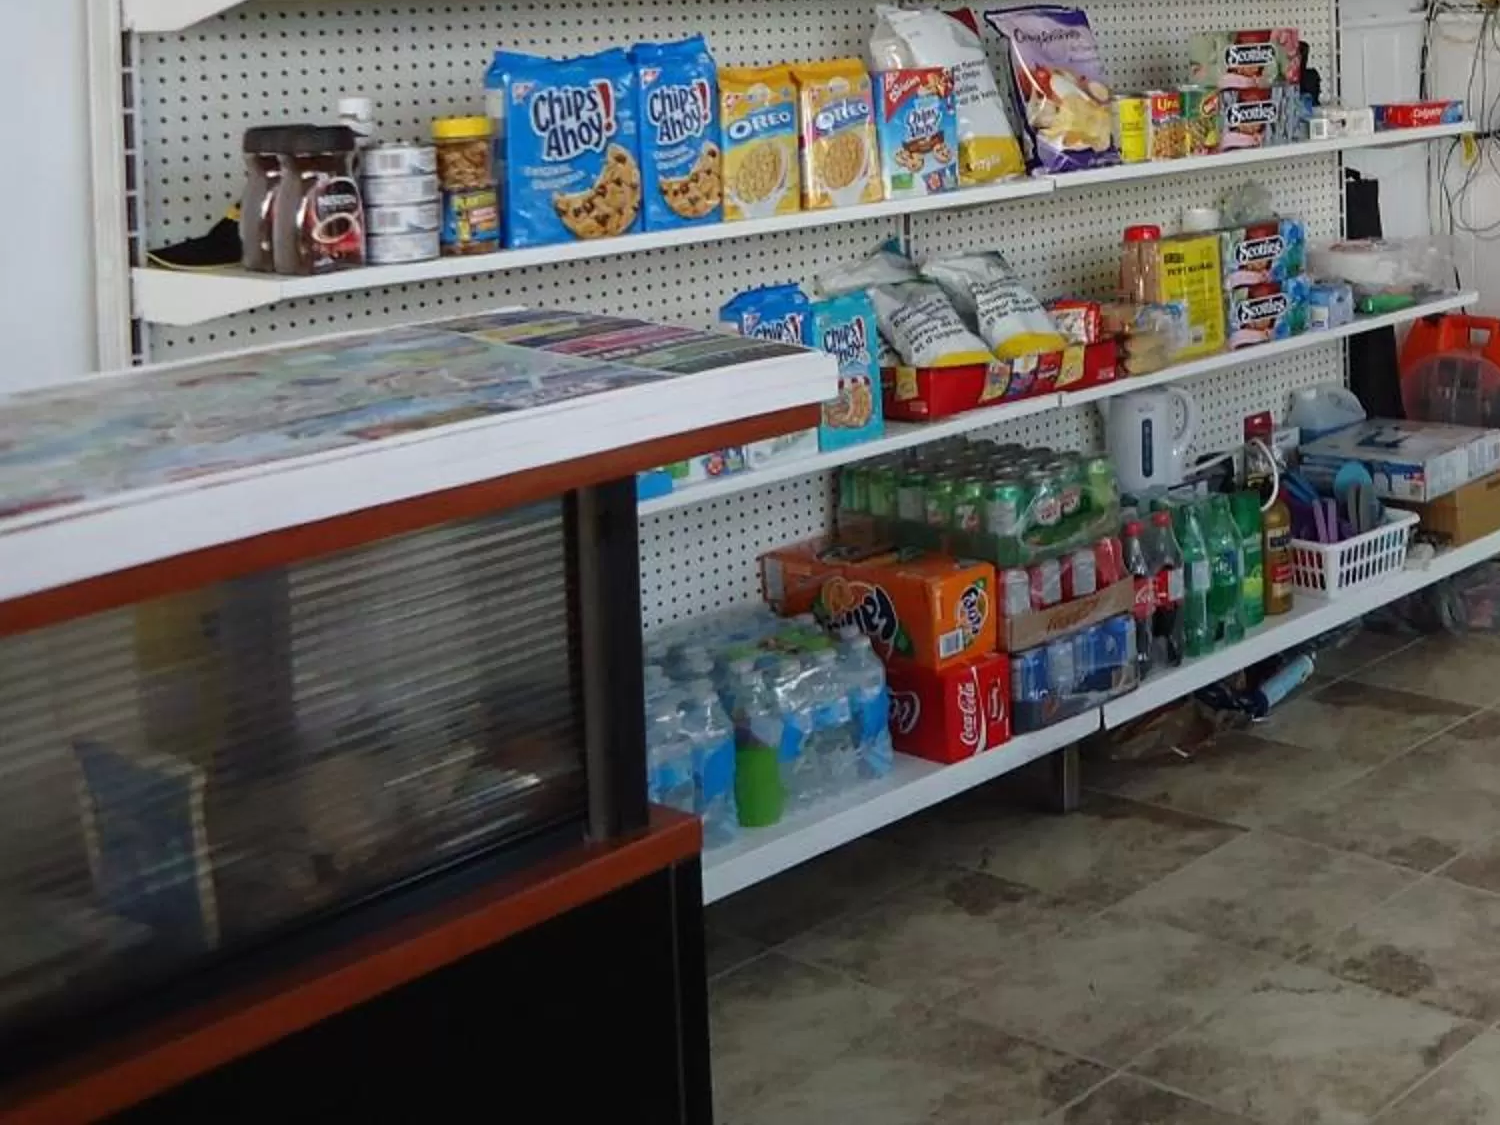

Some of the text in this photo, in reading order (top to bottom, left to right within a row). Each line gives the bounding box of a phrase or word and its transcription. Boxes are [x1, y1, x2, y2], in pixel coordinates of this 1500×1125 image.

[534, 86, 599, 132] Chips
[651, 86, 698, 123] Chips
[815, 101, 869, 131] OREO
[729, 110, 792, 139] OREO
